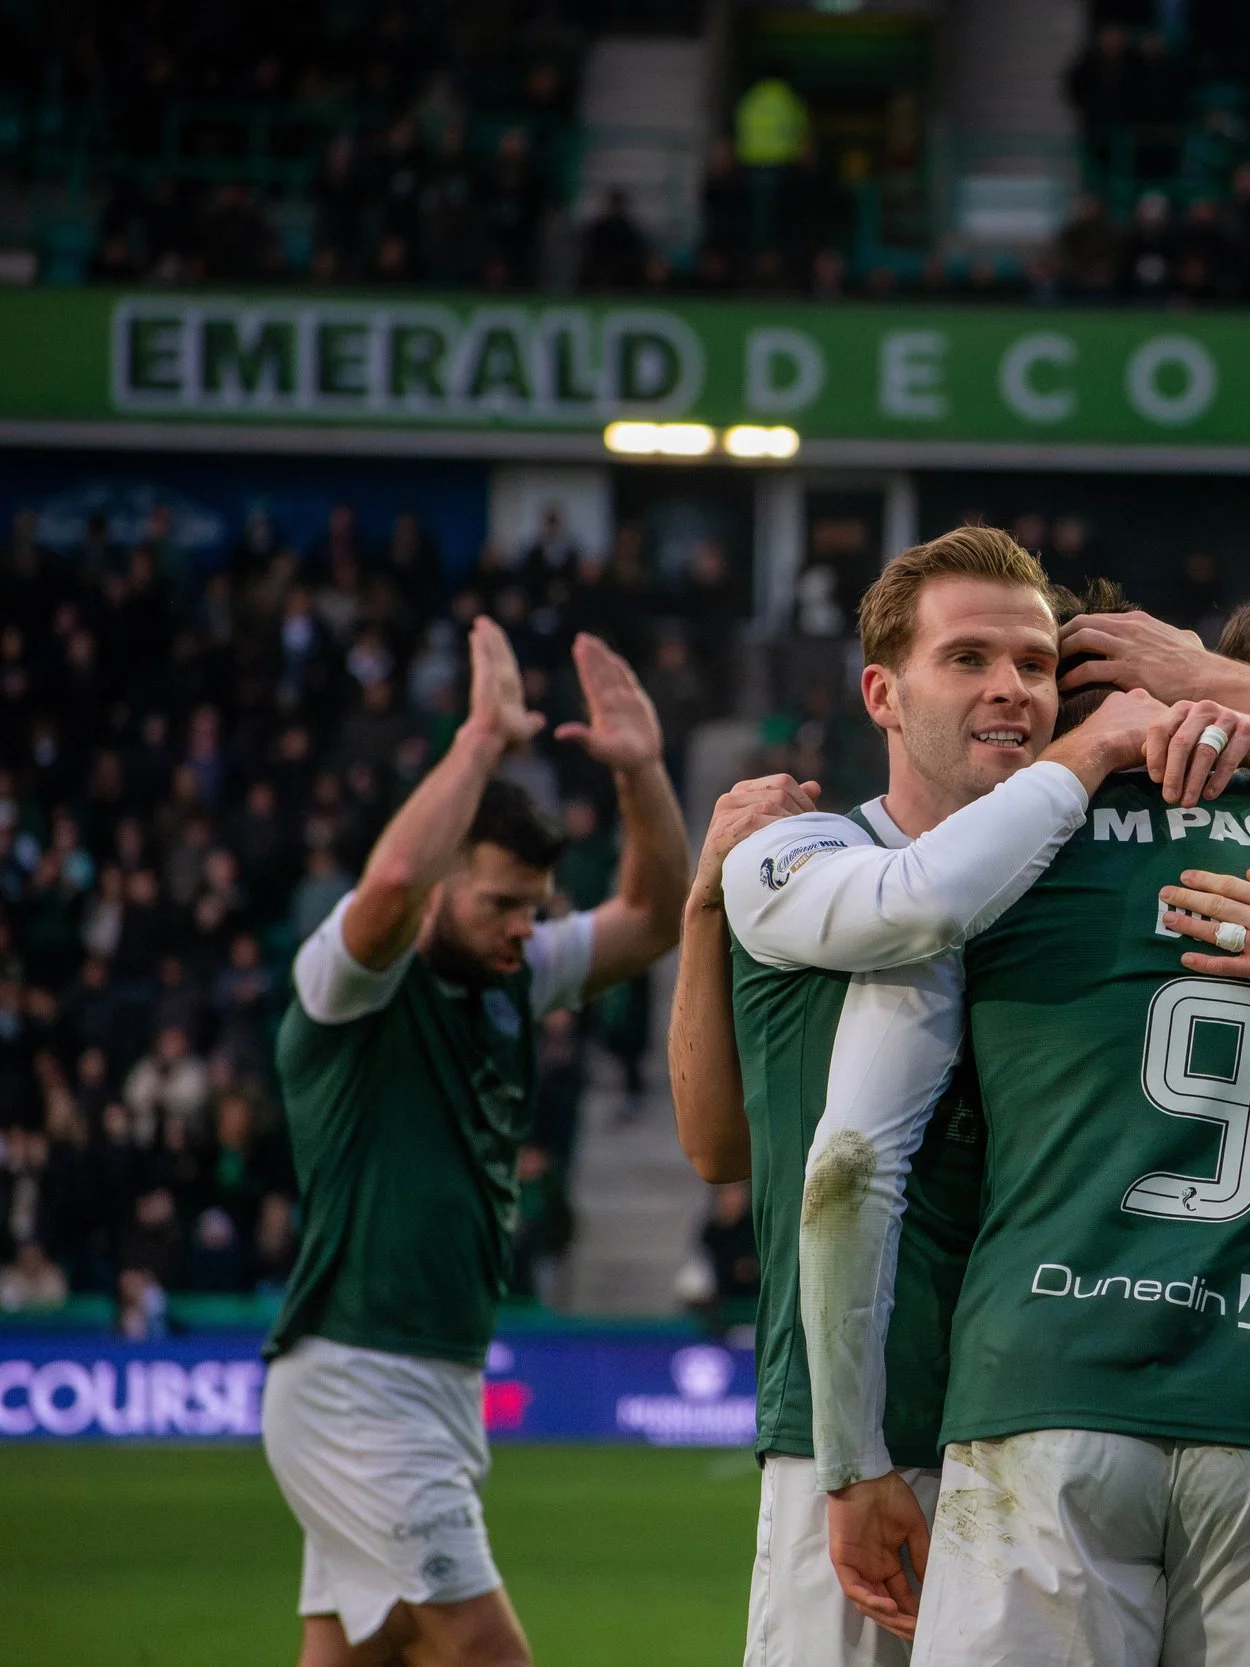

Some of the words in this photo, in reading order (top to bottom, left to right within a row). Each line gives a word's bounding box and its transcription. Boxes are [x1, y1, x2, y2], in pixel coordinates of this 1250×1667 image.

[116, 298, 702, 414] EMERALD
[1031, 1263, 1227, 1316] Dunedin
[0, 1359, 264, 1436] COURSE
